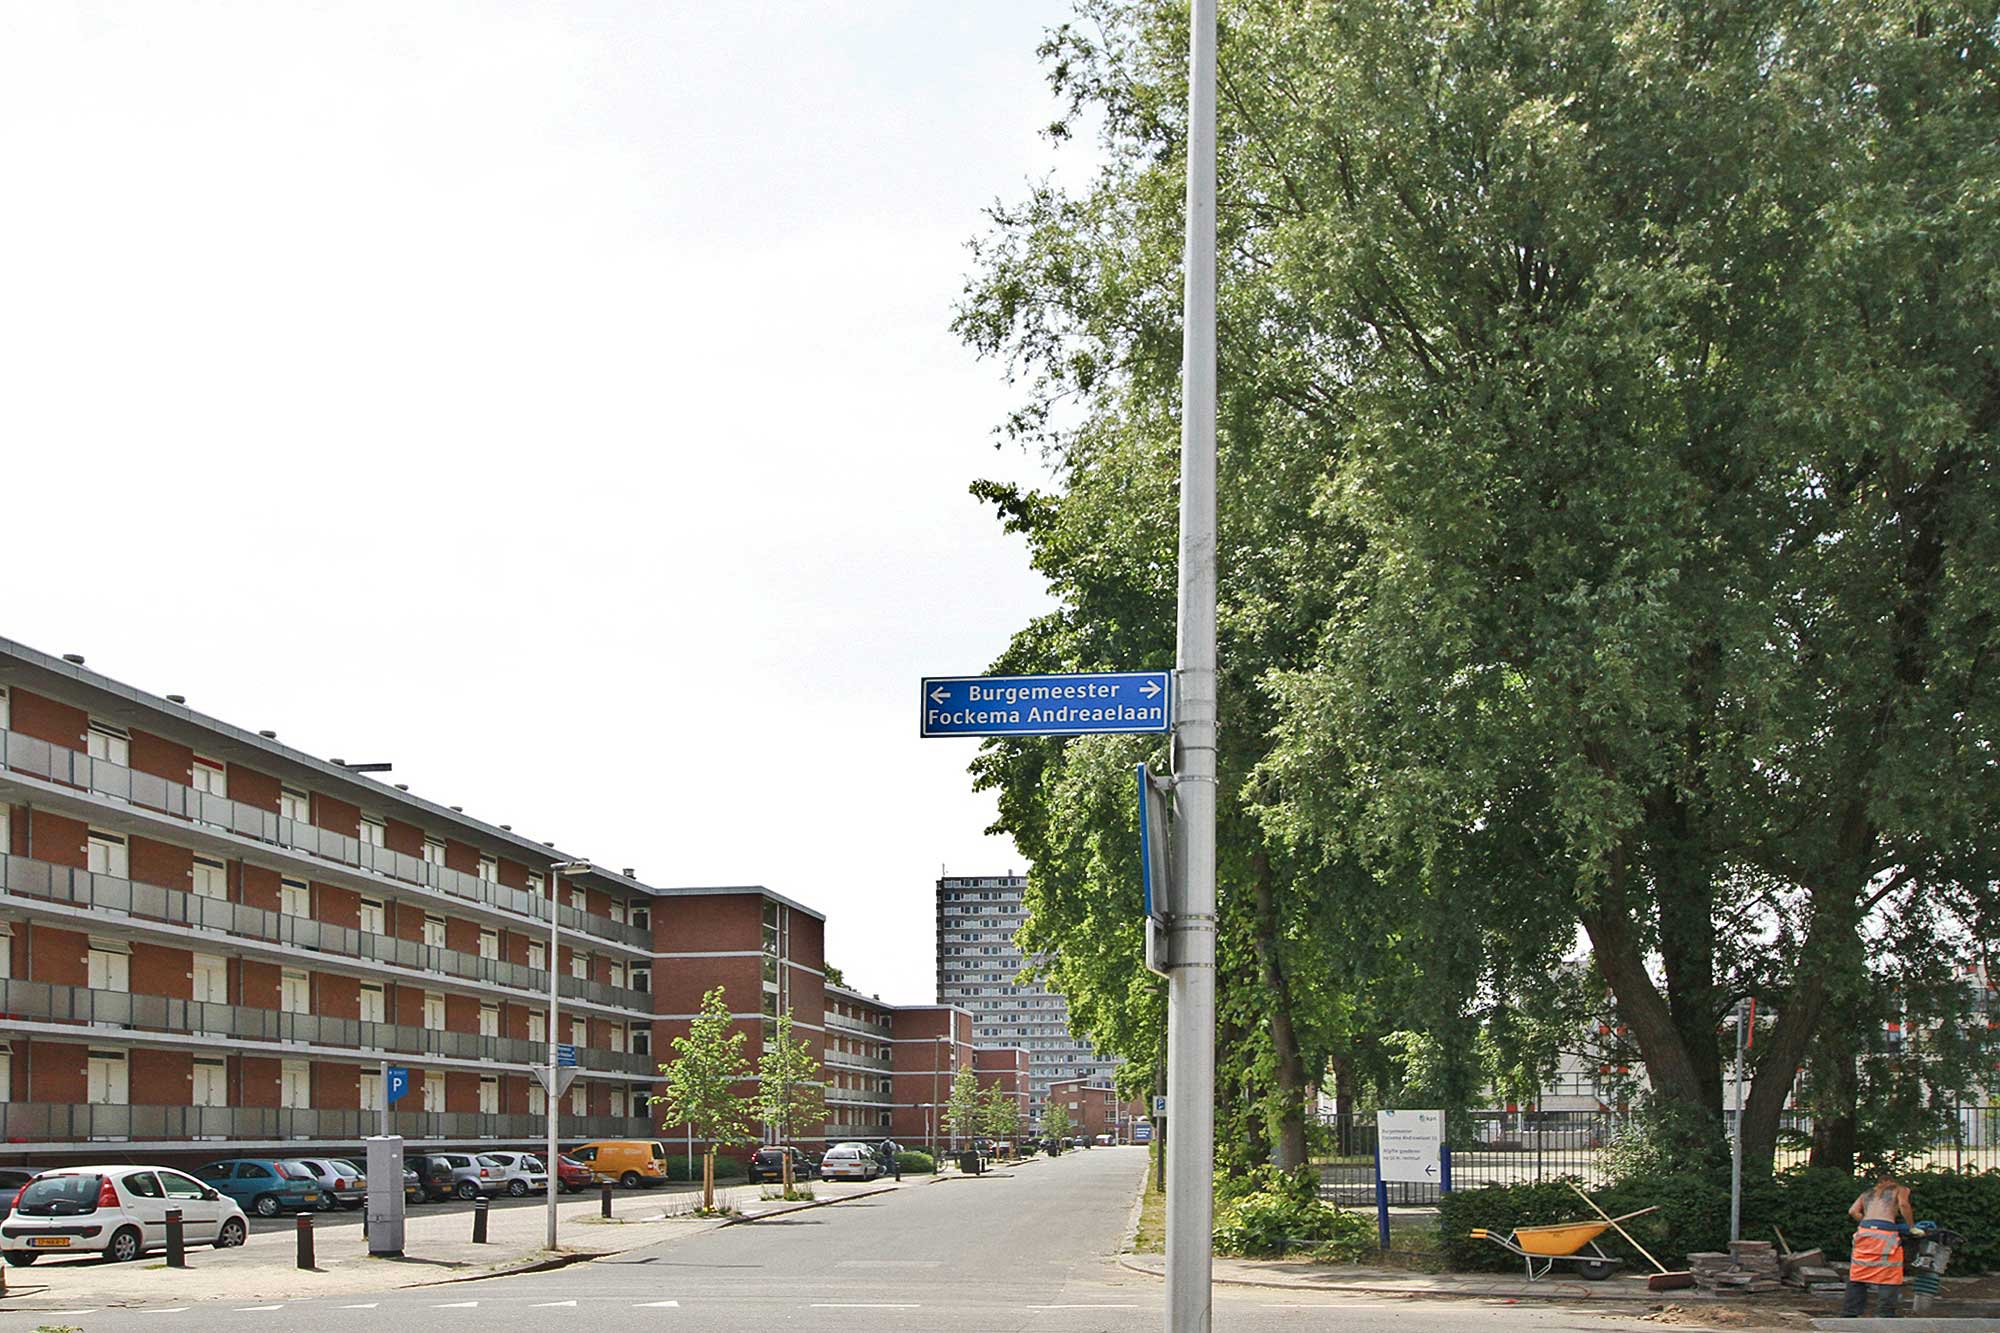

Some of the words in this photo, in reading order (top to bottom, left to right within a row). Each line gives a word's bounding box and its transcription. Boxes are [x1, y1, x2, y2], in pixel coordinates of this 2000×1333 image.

[969, 684, 1120, 703] Burgemeester
[928, 707, 1020, 725] Fockema
[1028, 704, 1162, 722] Andreaelaan
[393, 1077, 402, 1092] P
